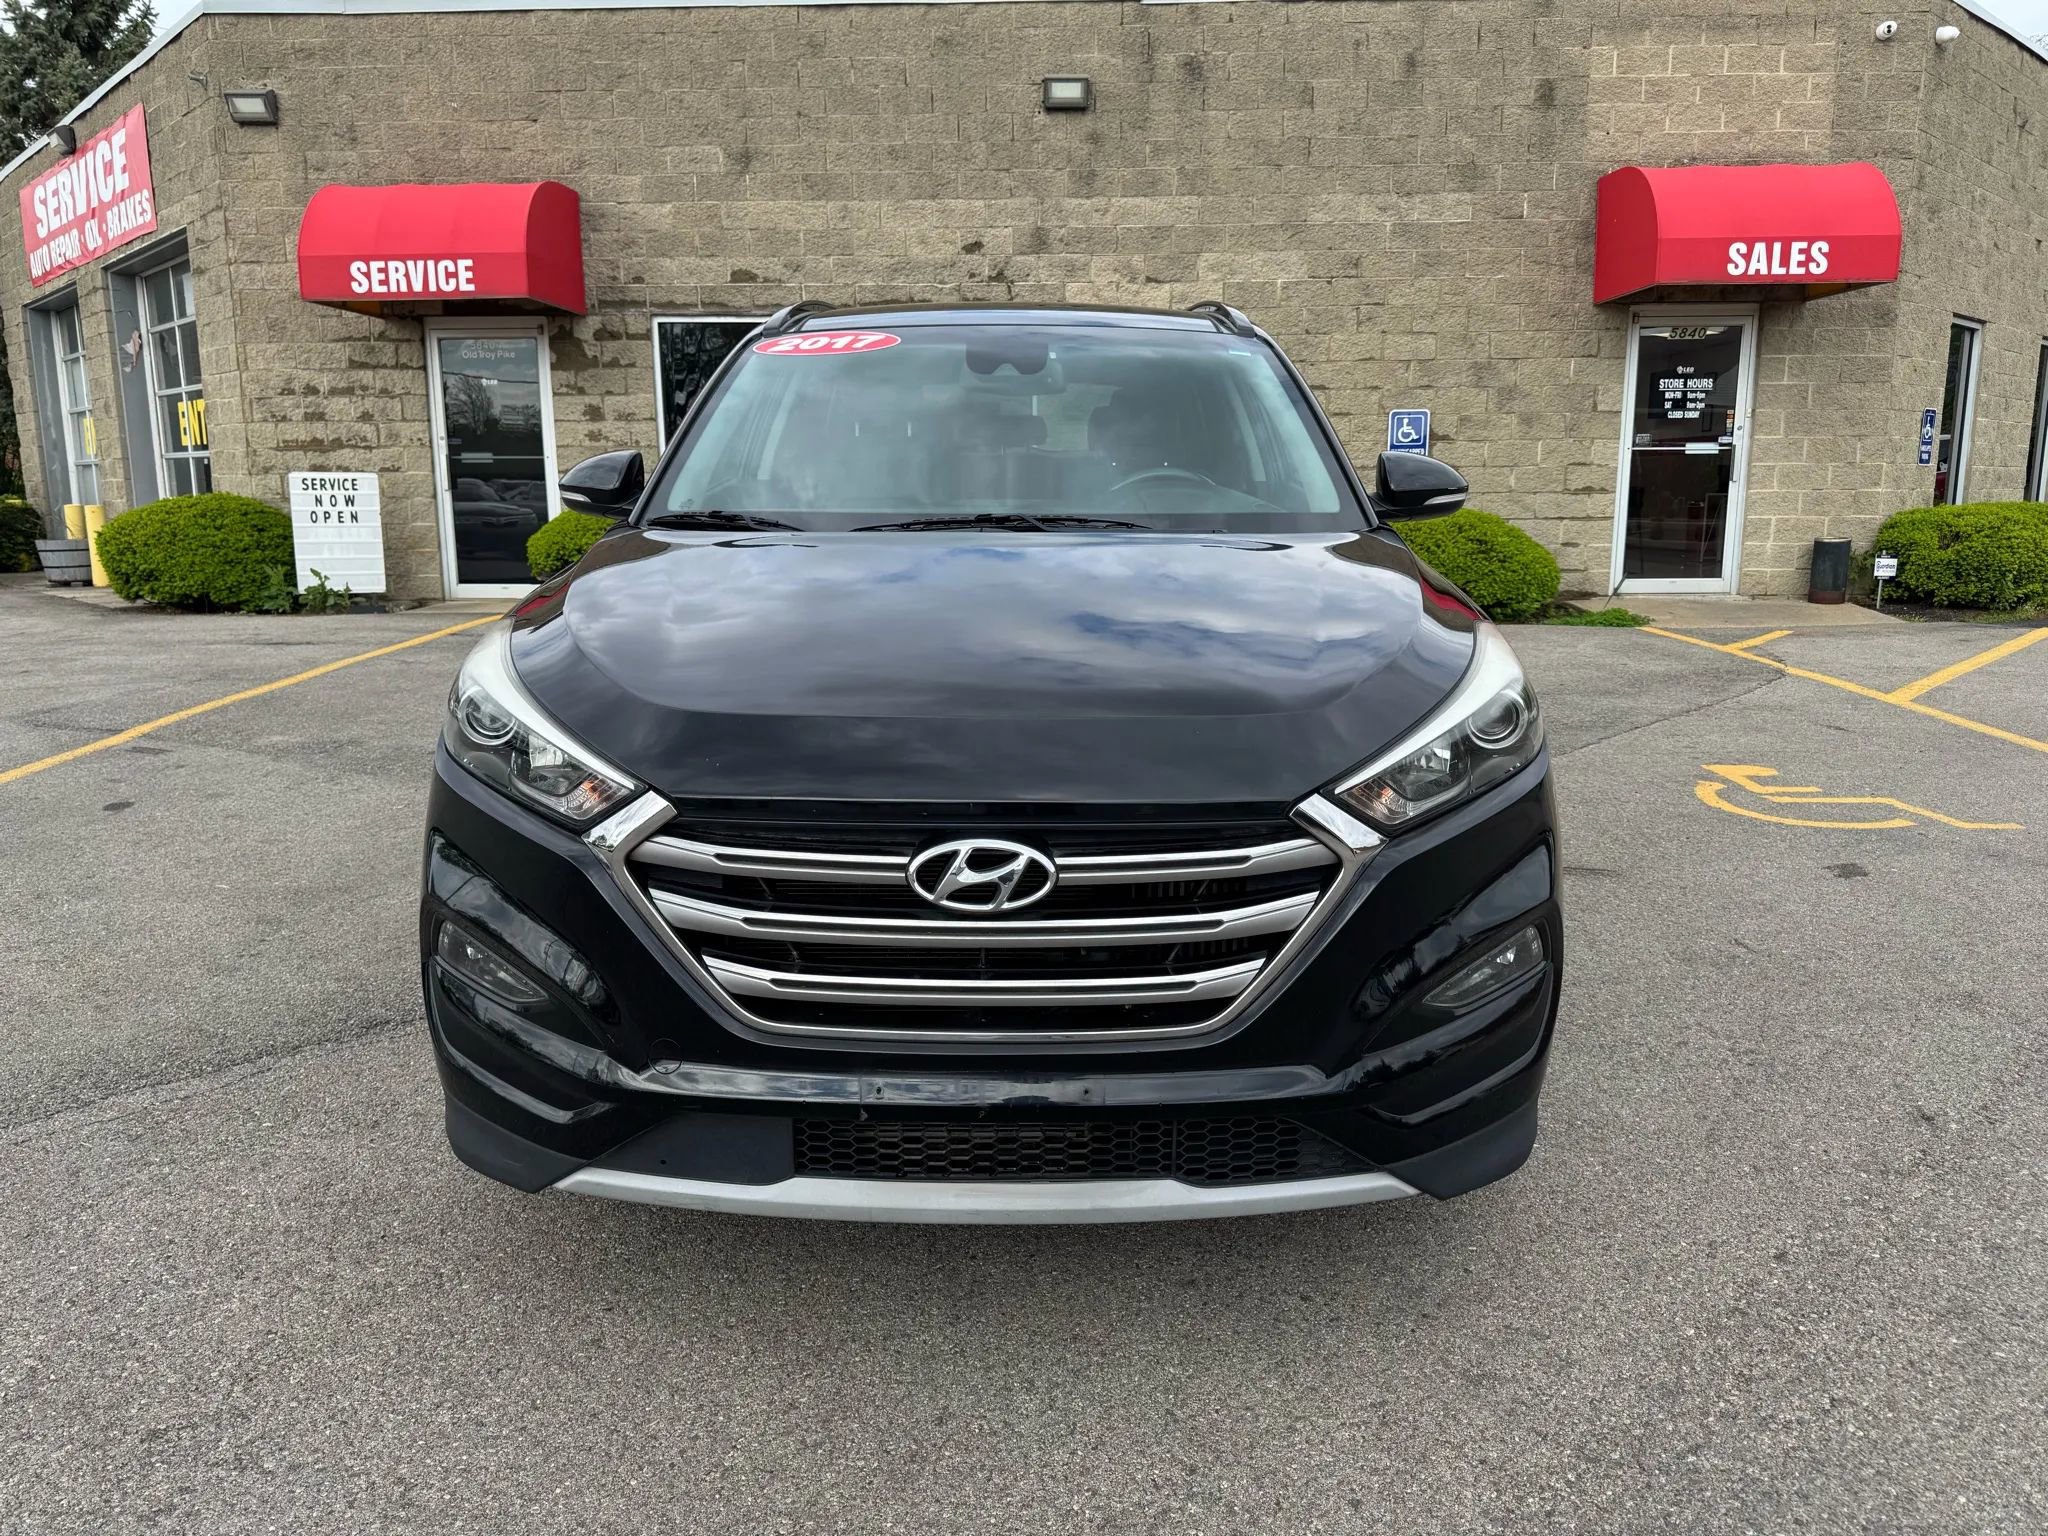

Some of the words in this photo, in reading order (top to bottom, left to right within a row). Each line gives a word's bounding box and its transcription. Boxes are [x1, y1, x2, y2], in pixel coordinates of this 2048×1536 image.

[33, 128, 129, 238] SERVICE
[30, 244, 50, 278] AUTO
[51, 228, 82, 268] REPAIR
[105, 188, 152, 241] BRAKES
[1727, 240, 1830, 276] SALES
[350, 259, 476, 294] SERVICE
[1670, 327, 1706, 338] 5840
[766, 335, 887, 353] 2017
[462, 350, 478, 359] Old
[478, 350, 496, 361] Troy
[497, 350, 516, 359] Pike
[1659, 379, 1684, 388] STORE
[1687, 379, 1713, 388] HOURS
[1664, 401, 1672, 409] SAT
[301, 478, 359, 491] SERVICE
[314, 494, 356, 507] NOW
[310, 510, 359, 524] OPEN
